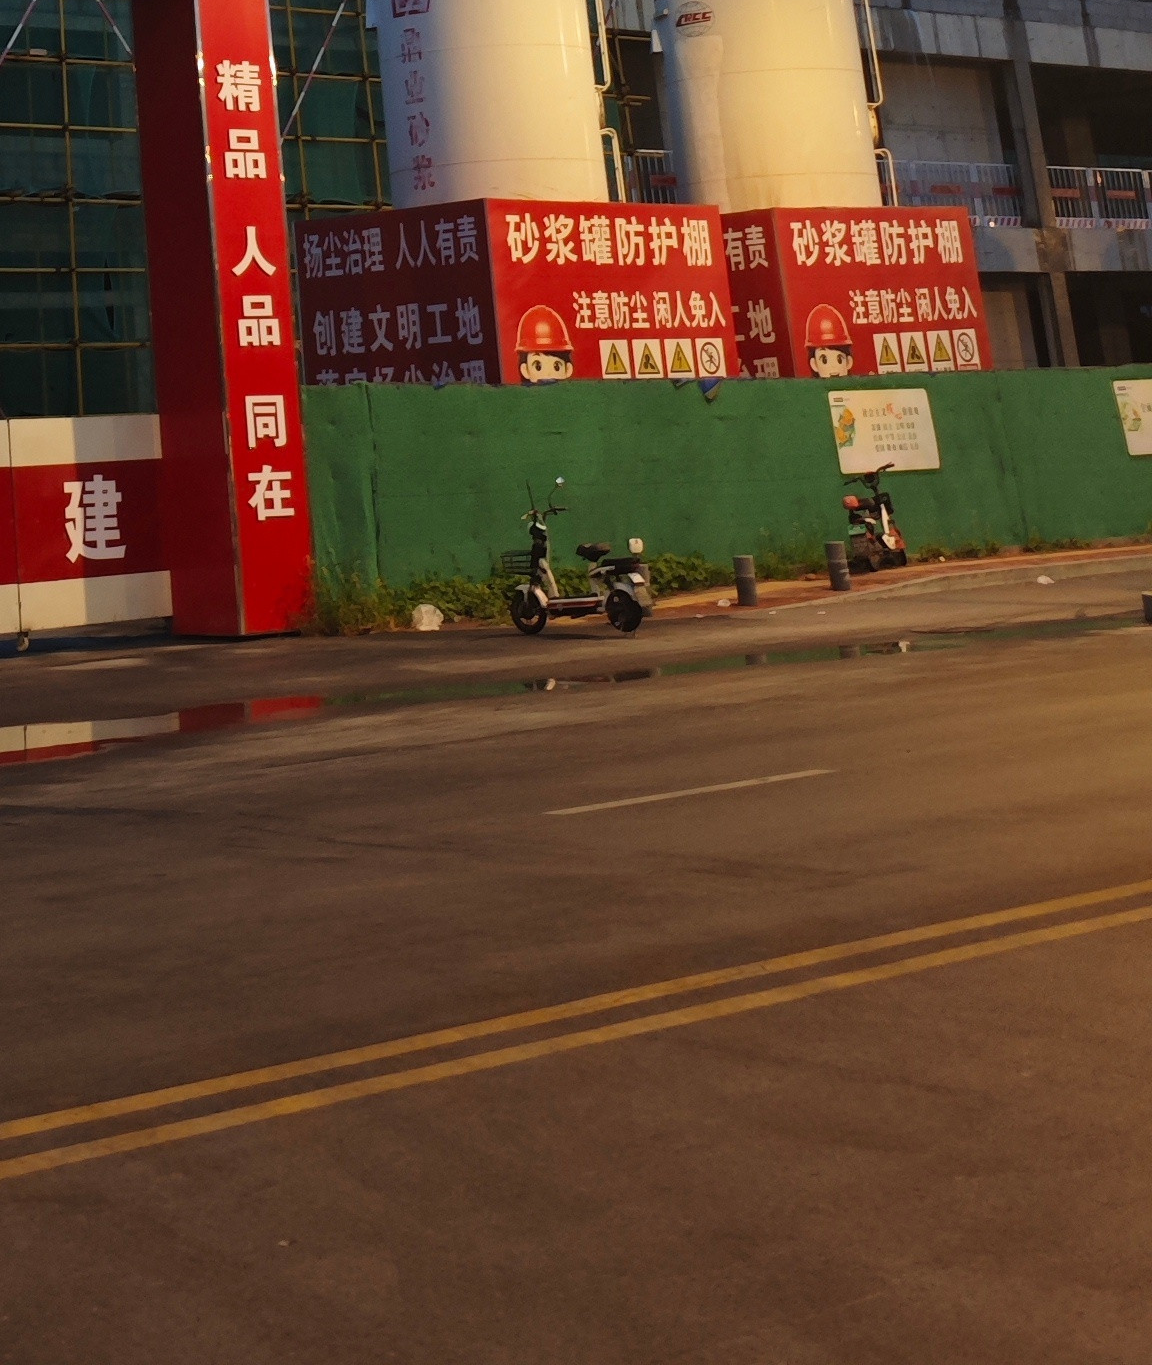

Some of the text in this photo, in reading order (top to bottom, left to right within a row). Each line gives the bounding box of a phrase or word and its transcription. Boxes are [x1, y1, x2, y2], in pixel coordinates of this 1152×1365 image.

[302, 214, 479, 279] 扬尘治理 人人有责
[505, 212, 713, 267] 砂浆罐防护棚
[789, 218, 964, 267] 砂浆罐防护棚
[216, 59, 296, 522] 精品 人品 同在
[572, 290, 727, 330] 注意防尘 闲人免入
[848, 285, 978, 325] 注意防尘 闲人免入
[312, 296, 483, 357] 创建文明工地
